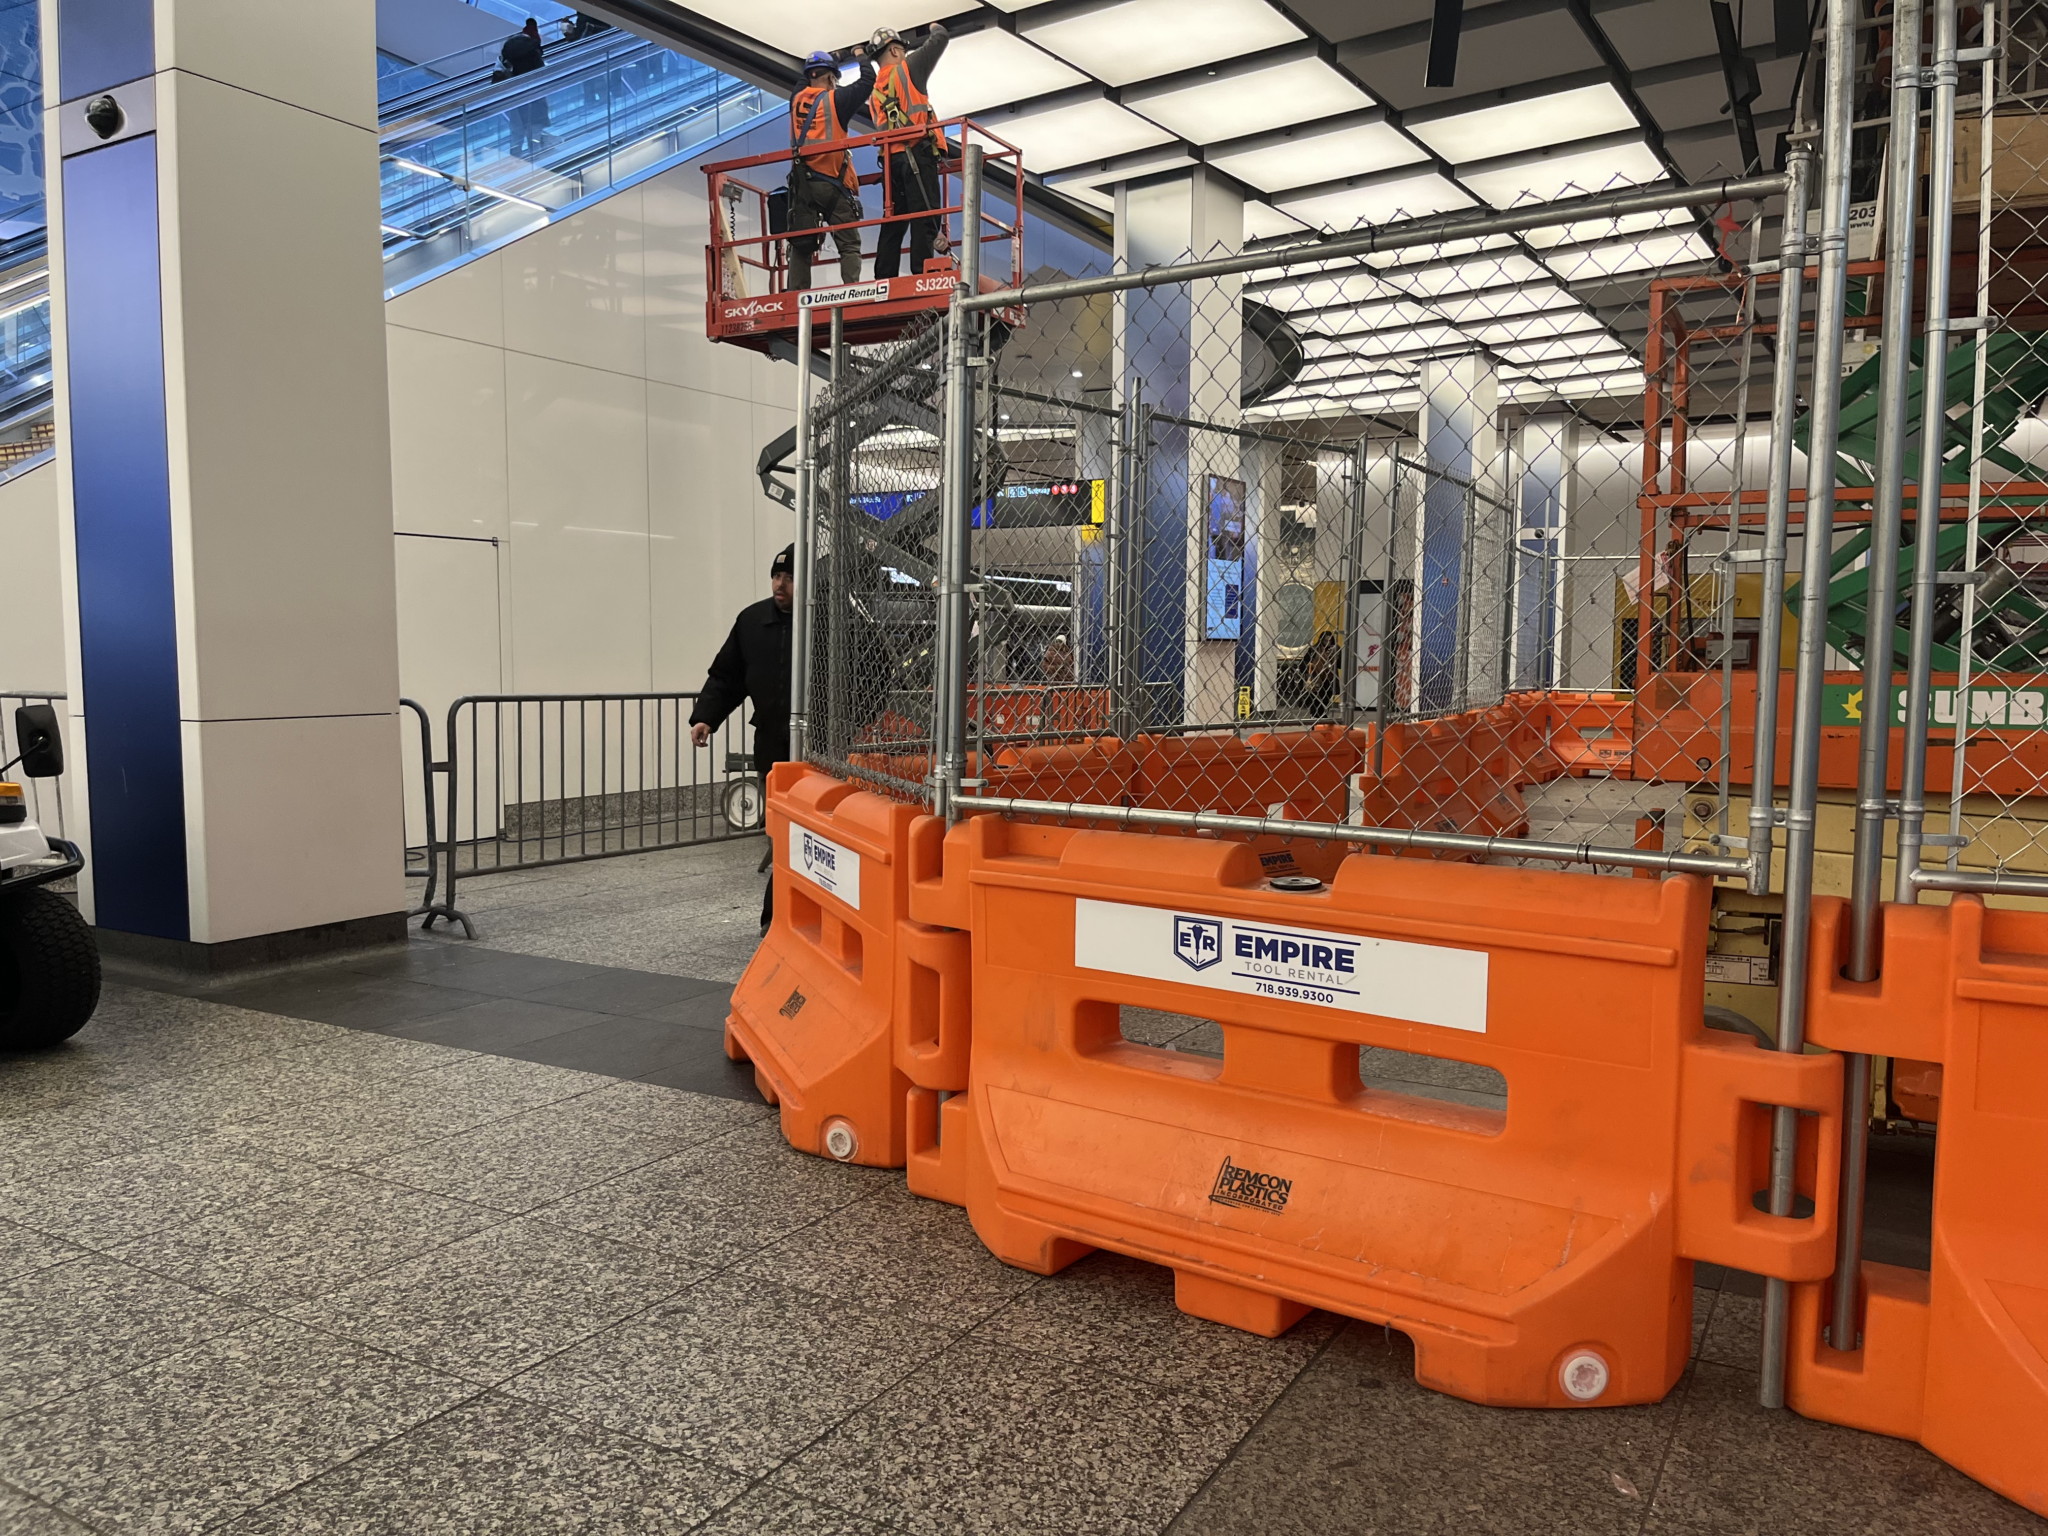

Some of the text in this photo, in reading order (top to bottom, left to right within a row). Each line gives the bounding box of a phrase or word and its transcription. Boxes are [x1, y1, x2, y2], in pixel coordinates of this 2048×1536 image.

[916, 276, 956, 293] SJ3220
[814, 290, 846, 304] United
[848, 288, 876, 301] Renta
[724, 300, 784, 318] SKYJACK
[1696, 597, 1742, 607] Trac 7
[1897, 690, 2048, 726] UNB
[814, 845, 836, 871] EMPIRE
[1260, 853, 1295, 867] EMPIRE
[1235, 933, 1355, 973] EMPIRE
[1244, 961, 1344, 986] TOOL RENTAL
[1255, 982, 1334, 1004] 718.939.9300
[1223, 1164, 1293, 1193] REMCON
[1216, 1189, 1284, 1211] INCORPORATED
[1218, 1177, 1289, 1205] PLASTICS
